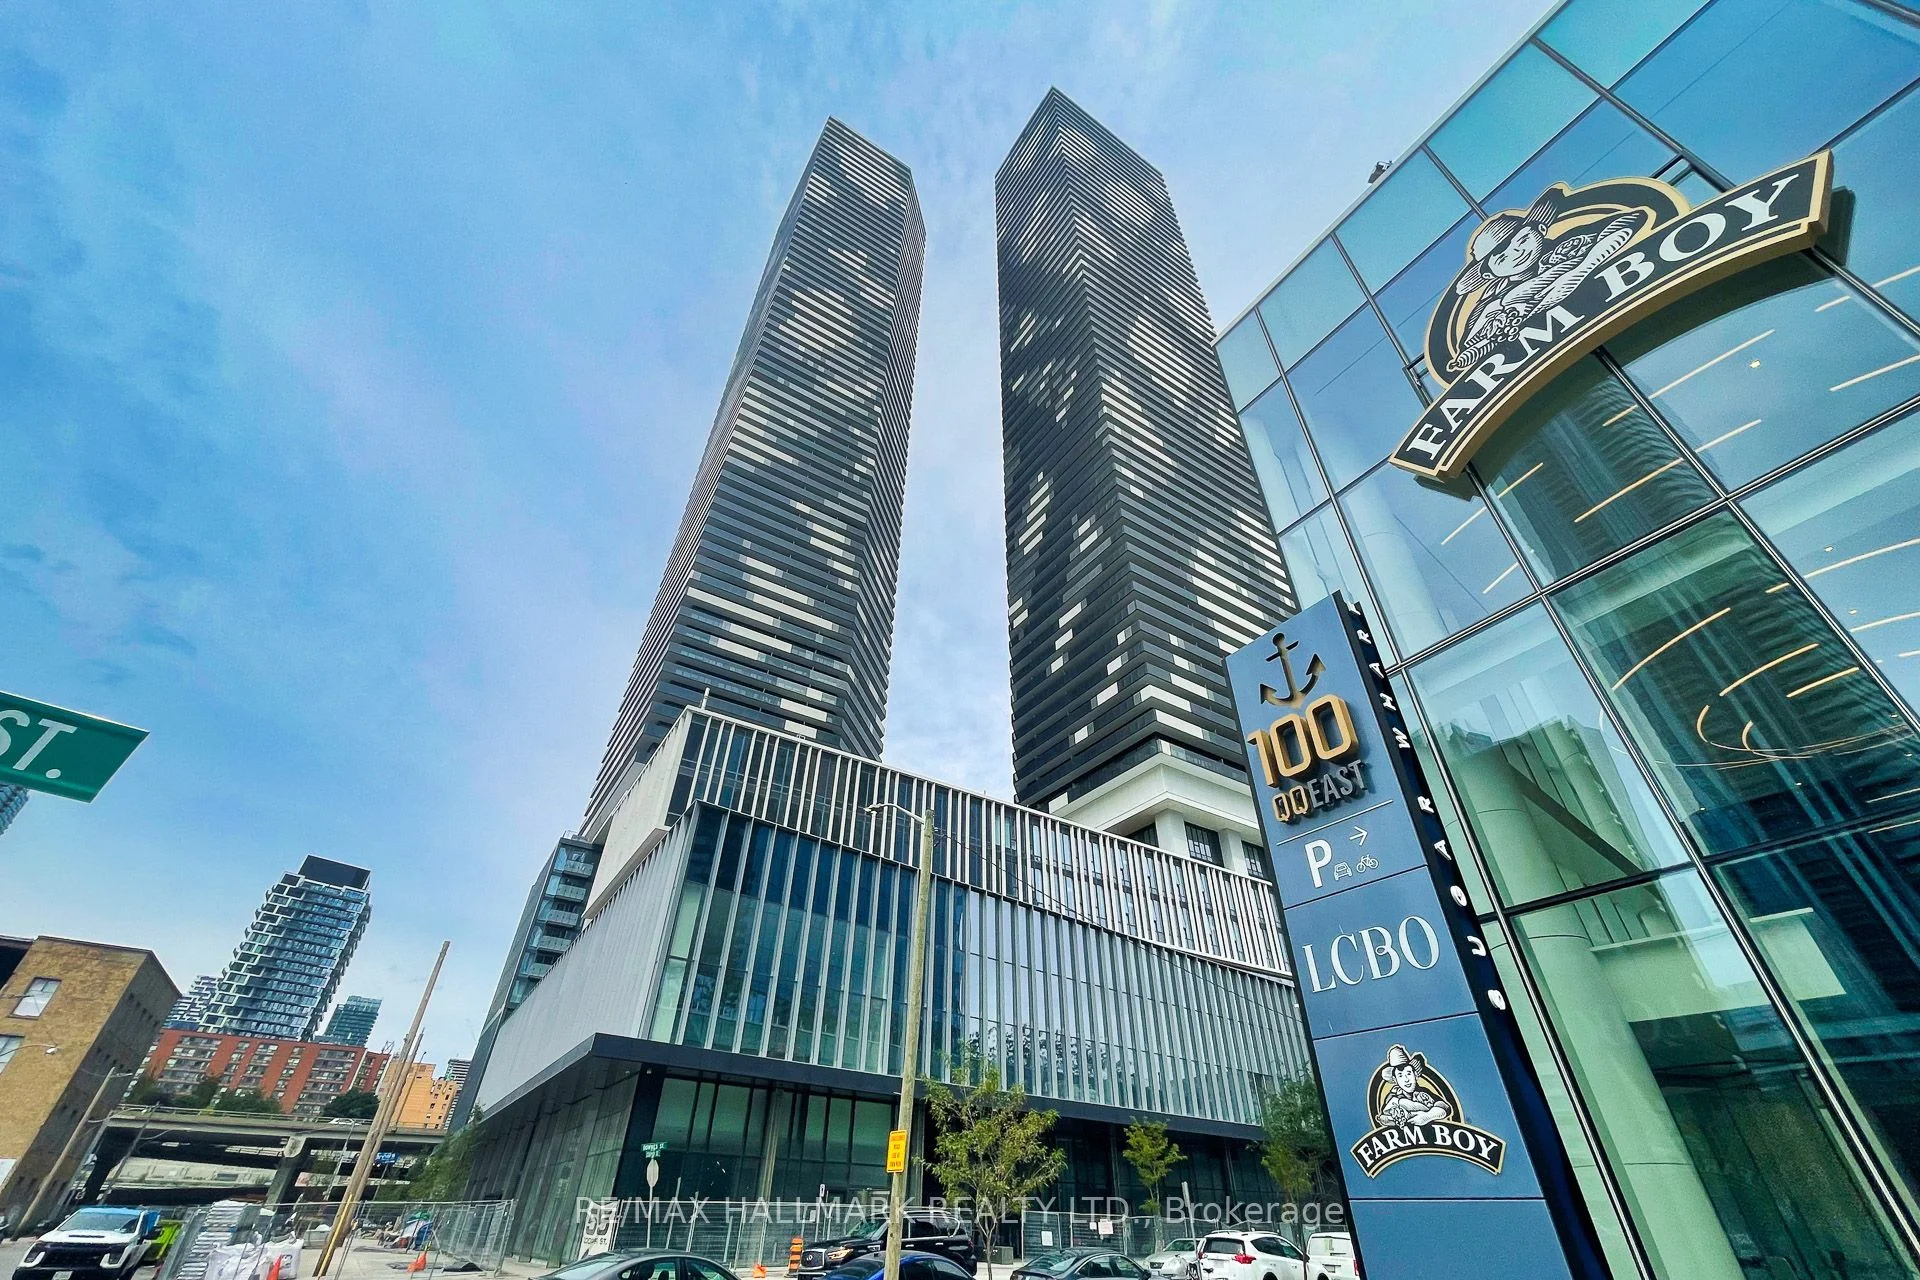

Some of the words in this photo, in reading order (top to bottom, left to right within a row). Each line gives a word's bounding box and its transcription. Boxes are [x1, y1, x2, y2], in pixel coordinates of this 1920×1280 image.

[1411, 307, 1585, 461] FARM
[1593, 173, 1800, 303] BOY
[0, 709, 78, 779] ST.
[1247, 693, 1358, 788] 100
[1304, 838, 1333, 888] P
[1302, 915, 1440, 994] LCBO
[1356, 1124, 1427, 1168] FARM
[1432, 1124, 1498, 1163] BOY
